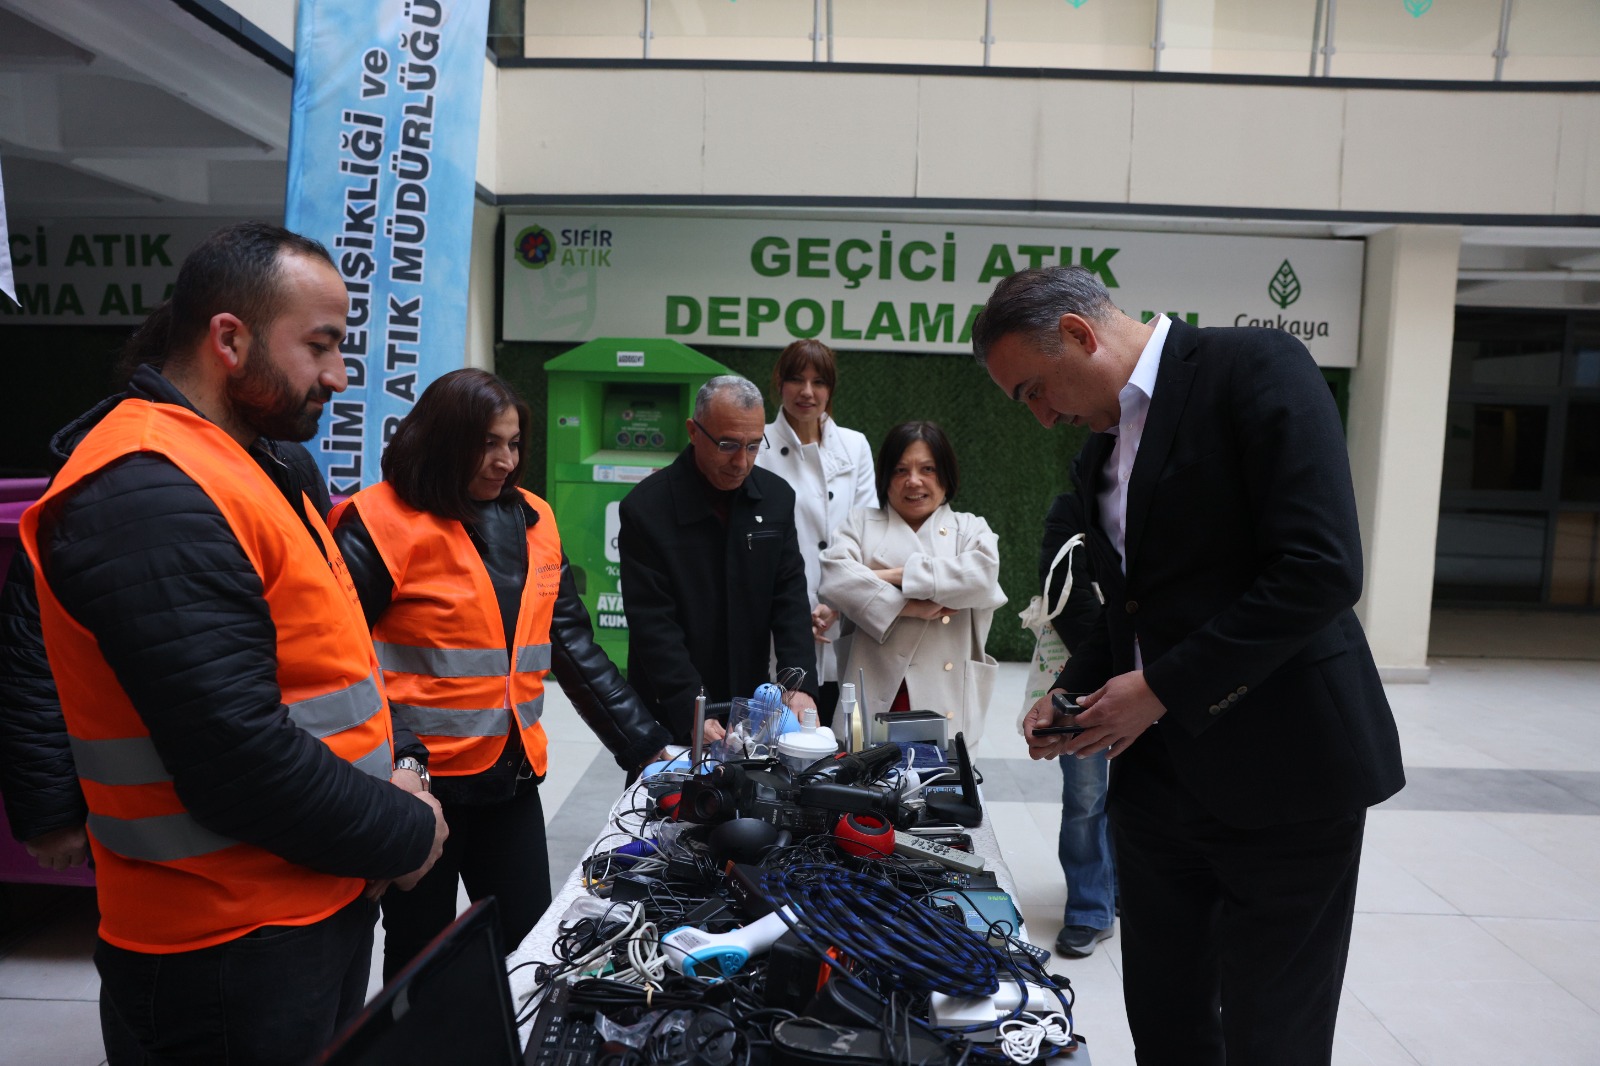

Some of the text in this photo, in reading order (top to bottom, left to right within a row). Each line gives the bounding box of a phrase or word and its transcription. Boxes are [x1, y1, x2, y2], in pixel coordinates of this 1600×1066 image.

[387, 0, 442, 282] MÜDÜRLÜĞÜ
[65, 234, 173, 267] ATIK
[561, 229, 612, 247] SIFIR
[561, 248, 612, 267] ATIK
[750, 230, 956, 289] GEÇİCİ
[323, 403, 364, 495] KLİM
[362, 50, 388, 97] ve
[386, 296, 421, 402] ATIK
